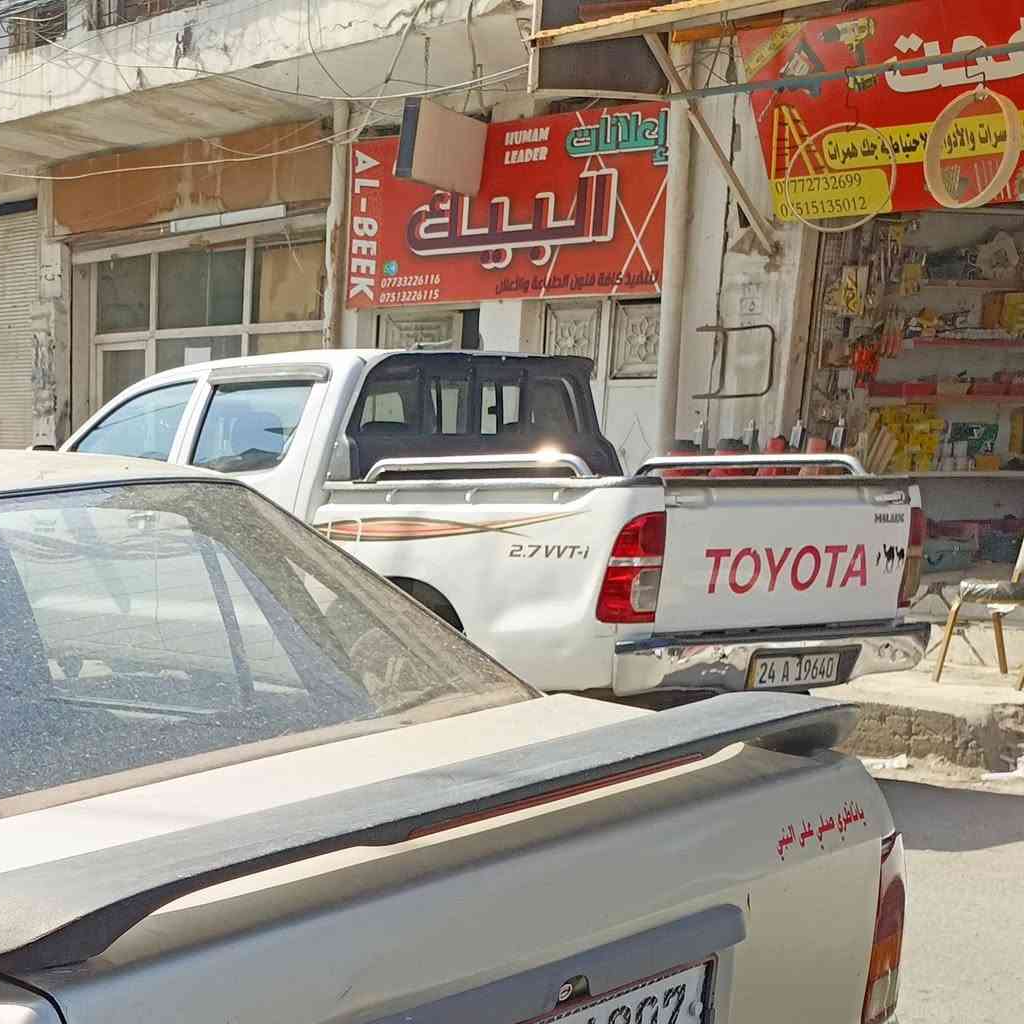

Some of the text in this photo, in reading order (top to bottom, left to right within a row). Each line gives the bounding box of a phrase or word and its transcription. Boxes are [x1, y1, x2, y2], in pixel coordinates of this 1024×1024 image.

[504, 147, 549, 165] LEADER
[349, 150, 381, 301] AL-BEEK
[509, 544, 541, 558] 2.7
[705, 543, 868, 595] TOYOTA
[759, 656, 834, 685] 24 A 19640
